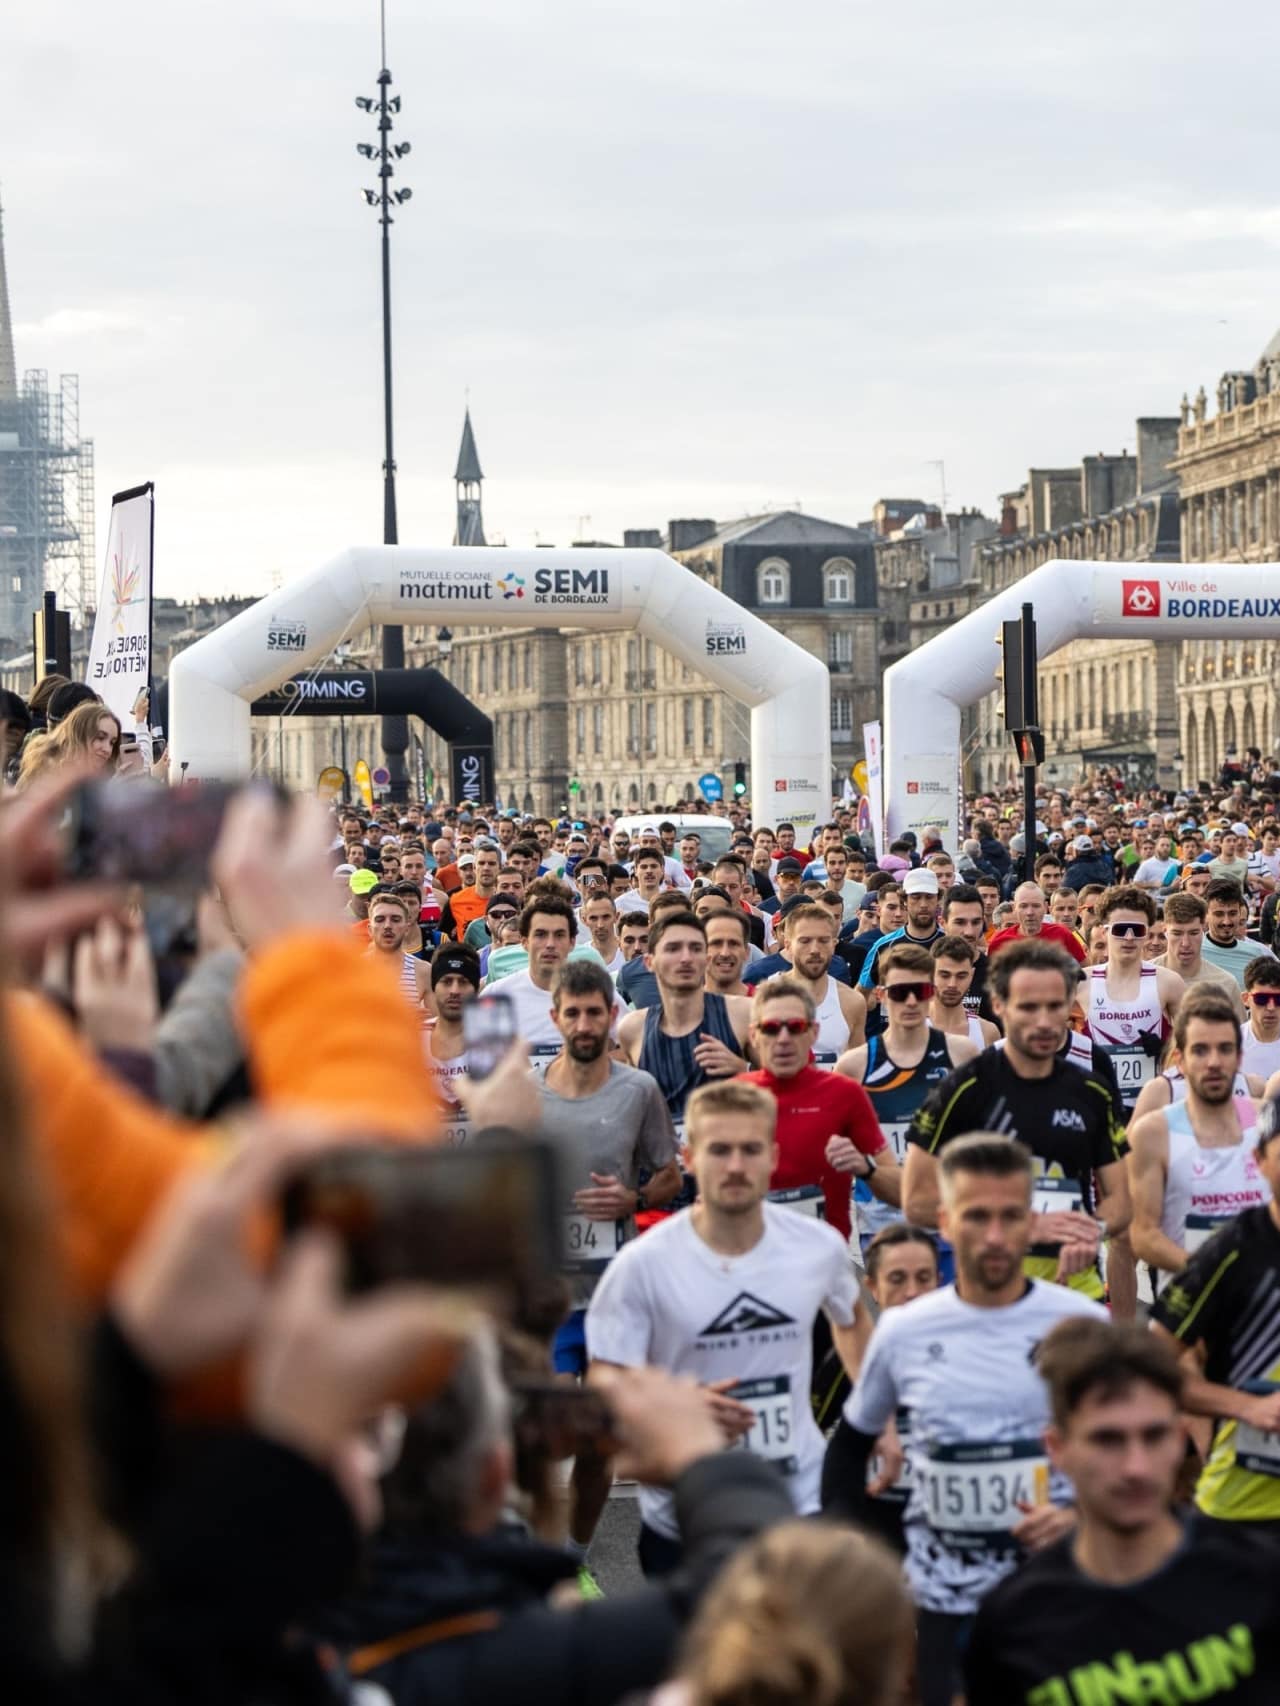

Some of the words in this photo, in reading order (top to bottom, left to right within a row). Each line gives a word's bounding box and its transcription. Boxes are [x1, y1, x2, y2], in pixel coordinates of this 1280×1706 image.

[400, 571, 451, 580] MUTUELLE
[454, 571, 492, 581] OCIANE
[534, 569, 608, 593] SEMI
[400, 581, 493, 599] matmut
[1167, 580, 1197, 592] Ville
[1201, 581, 1217, 592] de
[535, 595, 548, 604] DE
[551, 595, 609, 604] BORDEAUX
[267, 632, 306, 646] SEMI
[706, 636, 746, 650] SEMI
[1099, 1008, 1152, 1021] BORDEAUX
[747, 1329, 799, 1346] TRAIL
[929, 1474, 1030, 1516] 15134
